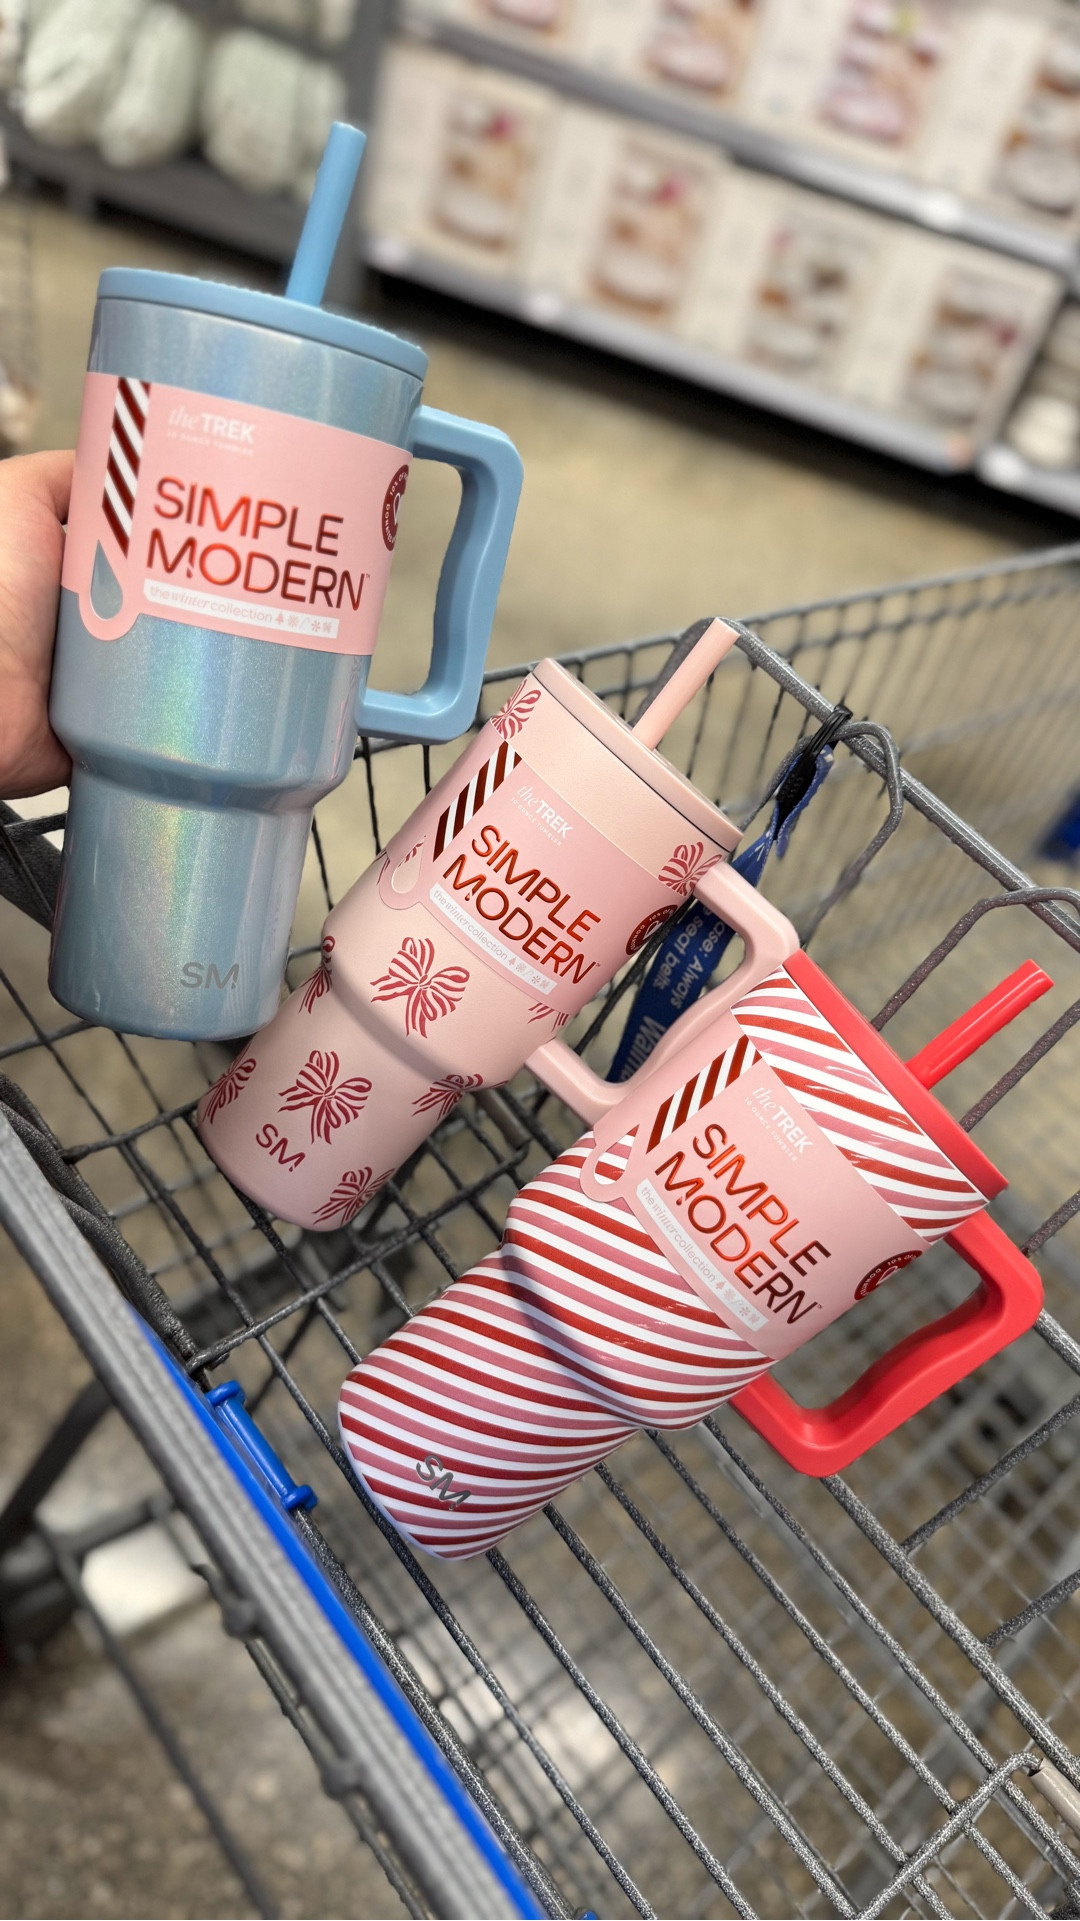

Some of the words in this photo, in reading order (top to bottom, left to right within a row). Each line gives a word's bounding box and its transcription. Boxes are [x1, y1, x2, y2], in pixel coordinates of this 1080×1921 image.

[168, 404, 199, 431] the
[201, 411, 256, 444] TREK
[154, 476, 344, 557] SIMPLE
[147, 528, 365, 611] MODERN
[150, 585, 170, 601] the
[171, 590, 211, 609] winter
[210, 600, 273, 623] collection
[516, 785, 539, 807] the
[535, 799, 574, 839] TREK
[471, 825, 602, 943] SIMPLE
[433, 889, 447, 906] the
[445, 901, 470, 927] winter
[467, 922, 509, 961] collection
[442, 854, 597, 985] MODERN
[673, 915, 704, 956] seat
[179, 961, 240, 990] SM
[670, 954, 704, 1010] Always
[255, 1123, 306, 1173] SM
[752, 1086, 777, 1111] the
[771, 1104, 813, 1154] TREK
[693, 1123, 832, 1277] SIMPLE
[640, 1186, 655, 1206] the
[652, 1201, 679, 1235] winter
[674, 1232, 716, 1283] collection
[654, 1150, 818, 1324] MODERN
[416, 1454, 472, 1512] SM
